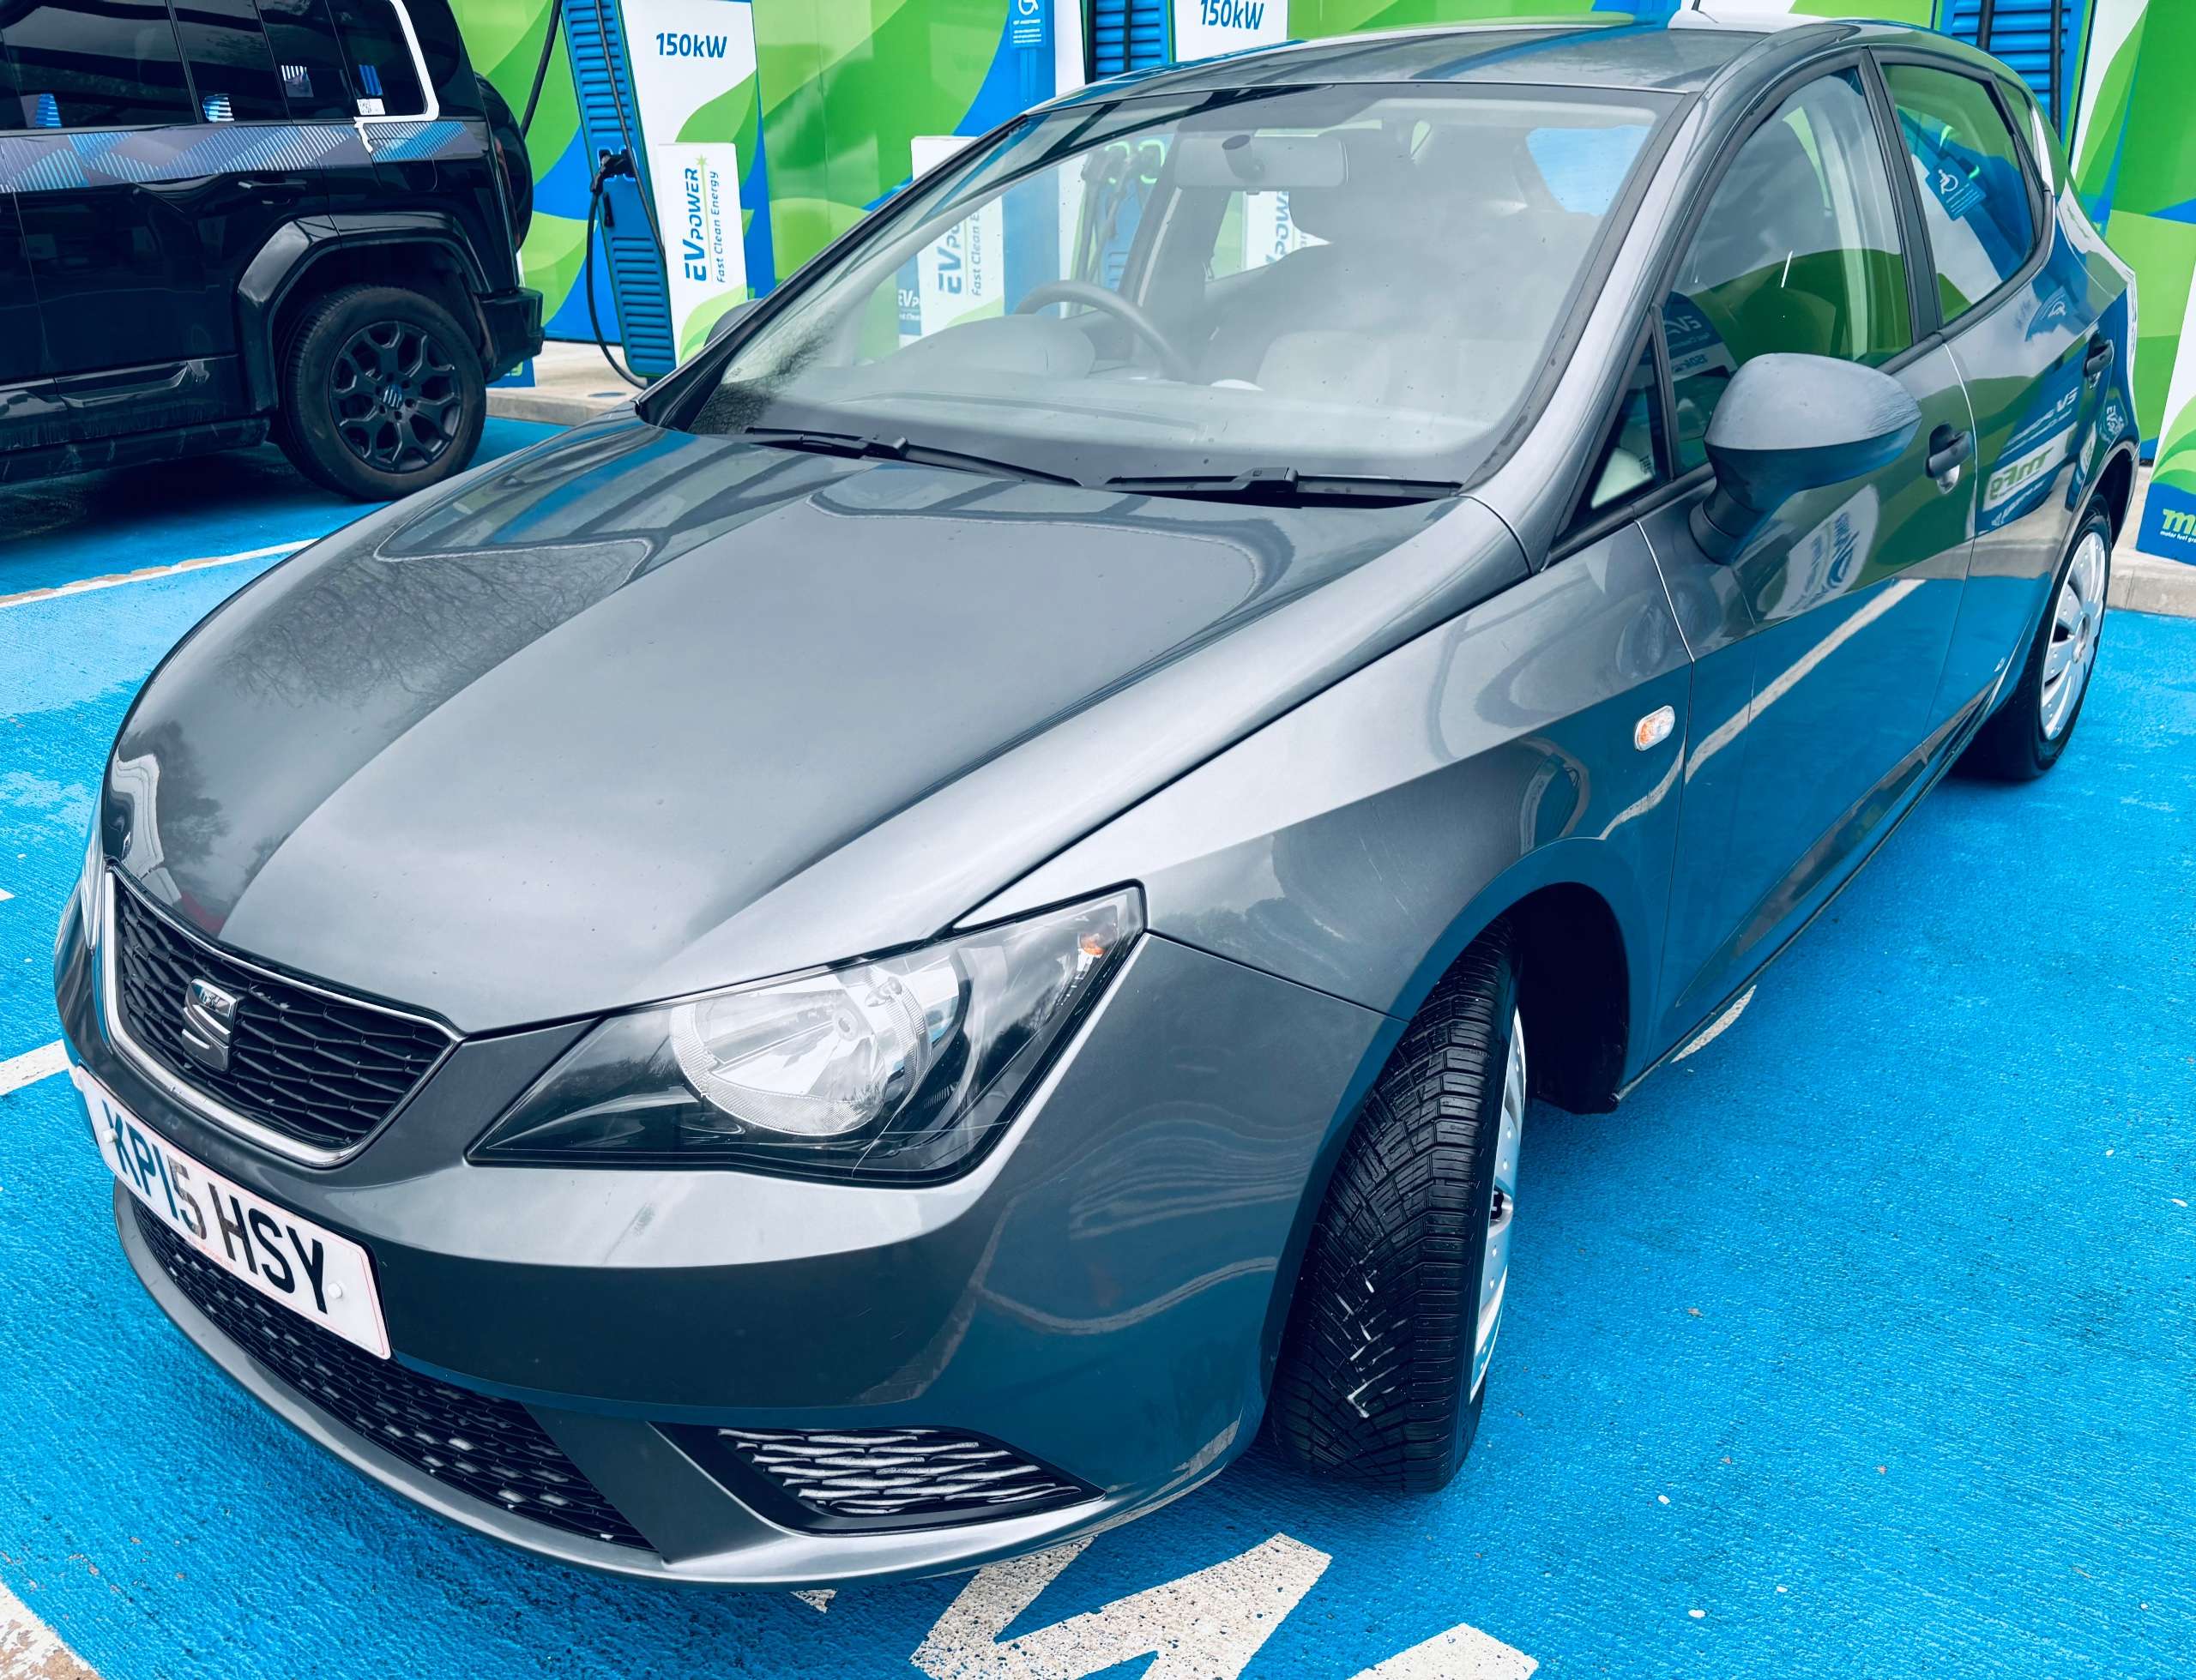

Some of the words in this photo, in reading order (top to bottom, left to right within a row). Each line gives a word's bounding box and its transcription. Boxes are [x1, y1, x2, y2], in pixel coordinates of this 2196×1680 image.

[1201, 0, 1264, 30] 150kW
[655, 33, 727, 58] 150kW
[709, 171, 721, 216] Energy
[714, 220, 724, 256] Clean
[971, 226, 981, 265] Clean
[717, 259, 726, 283] Fast
[972, 268, 981, 297] Fast
[2162, 509, 2196, 537] m
[2176, 533, 2188, 541] fuel
[102, 1099, 208, 1240] KP15
[208, 1182, 328, 1316] HSY
